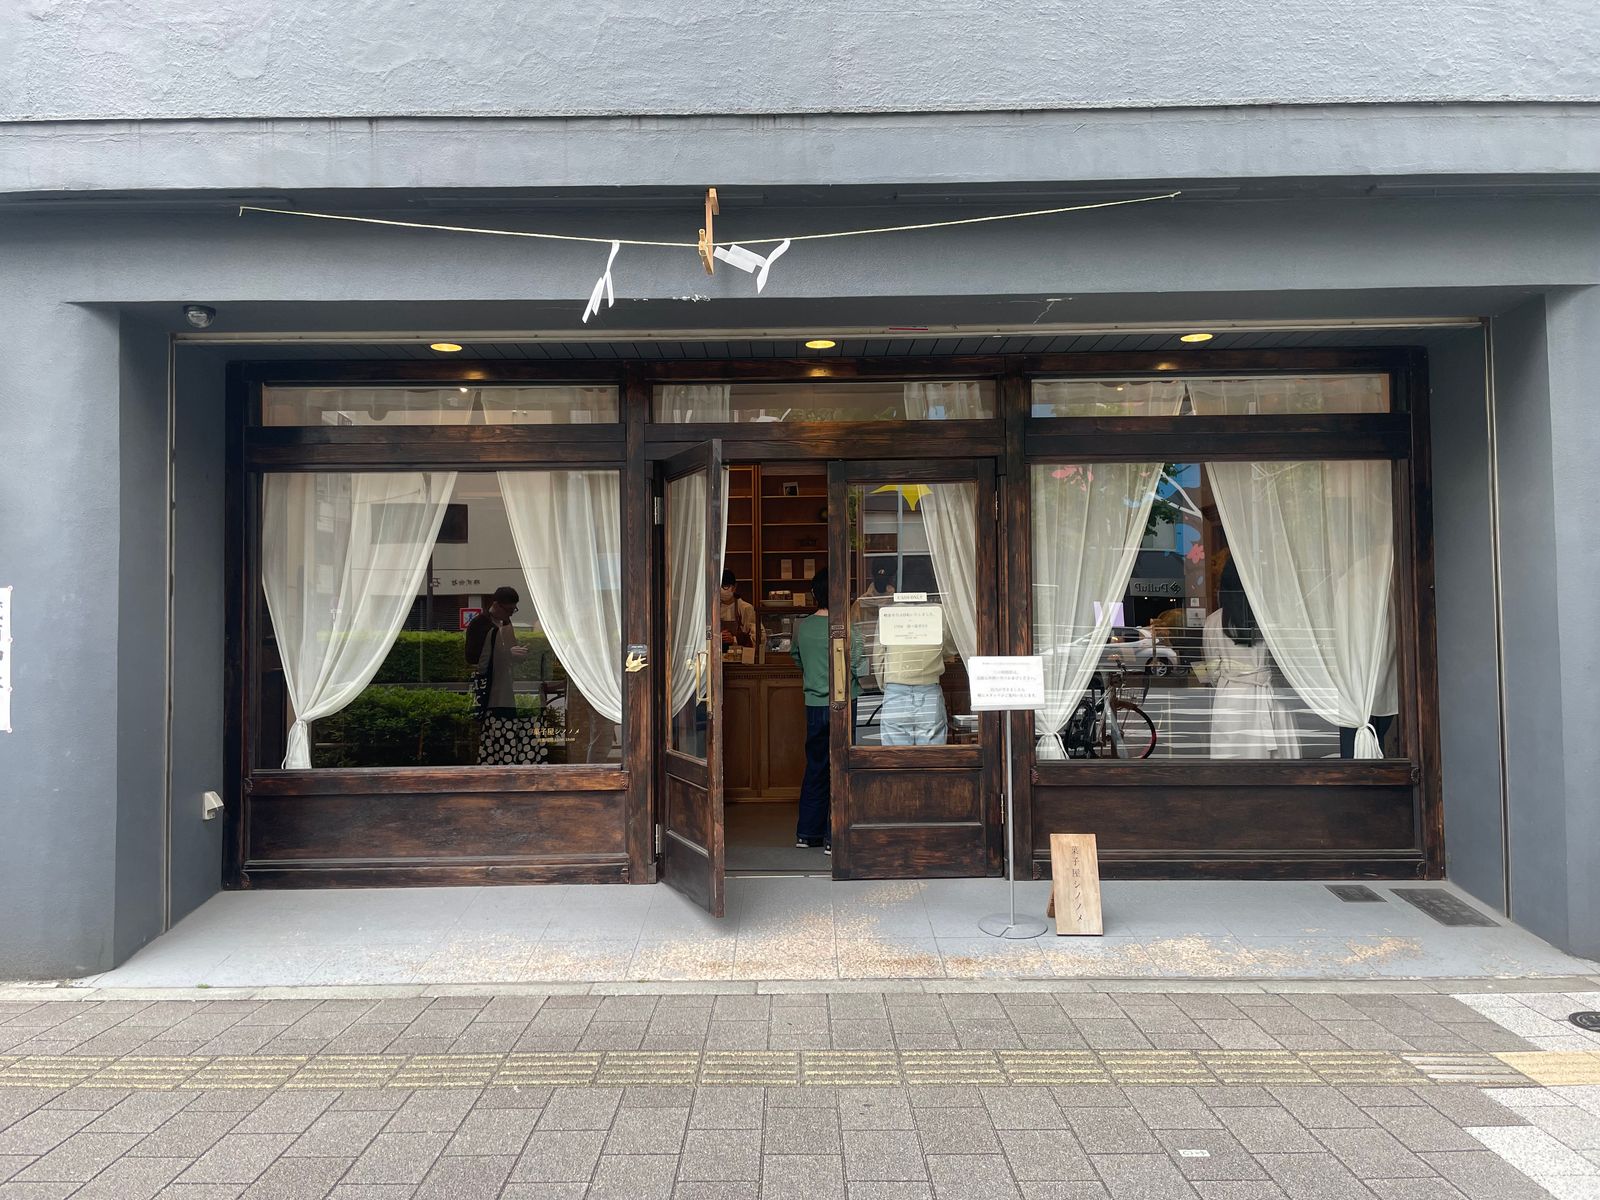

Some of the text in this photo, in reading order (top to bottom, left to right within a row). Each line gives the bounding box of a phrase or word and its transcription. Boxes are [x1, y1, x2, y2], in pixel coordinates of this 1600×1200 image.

[1071, 845, 1083, 922] 菓子屋シノノメ
